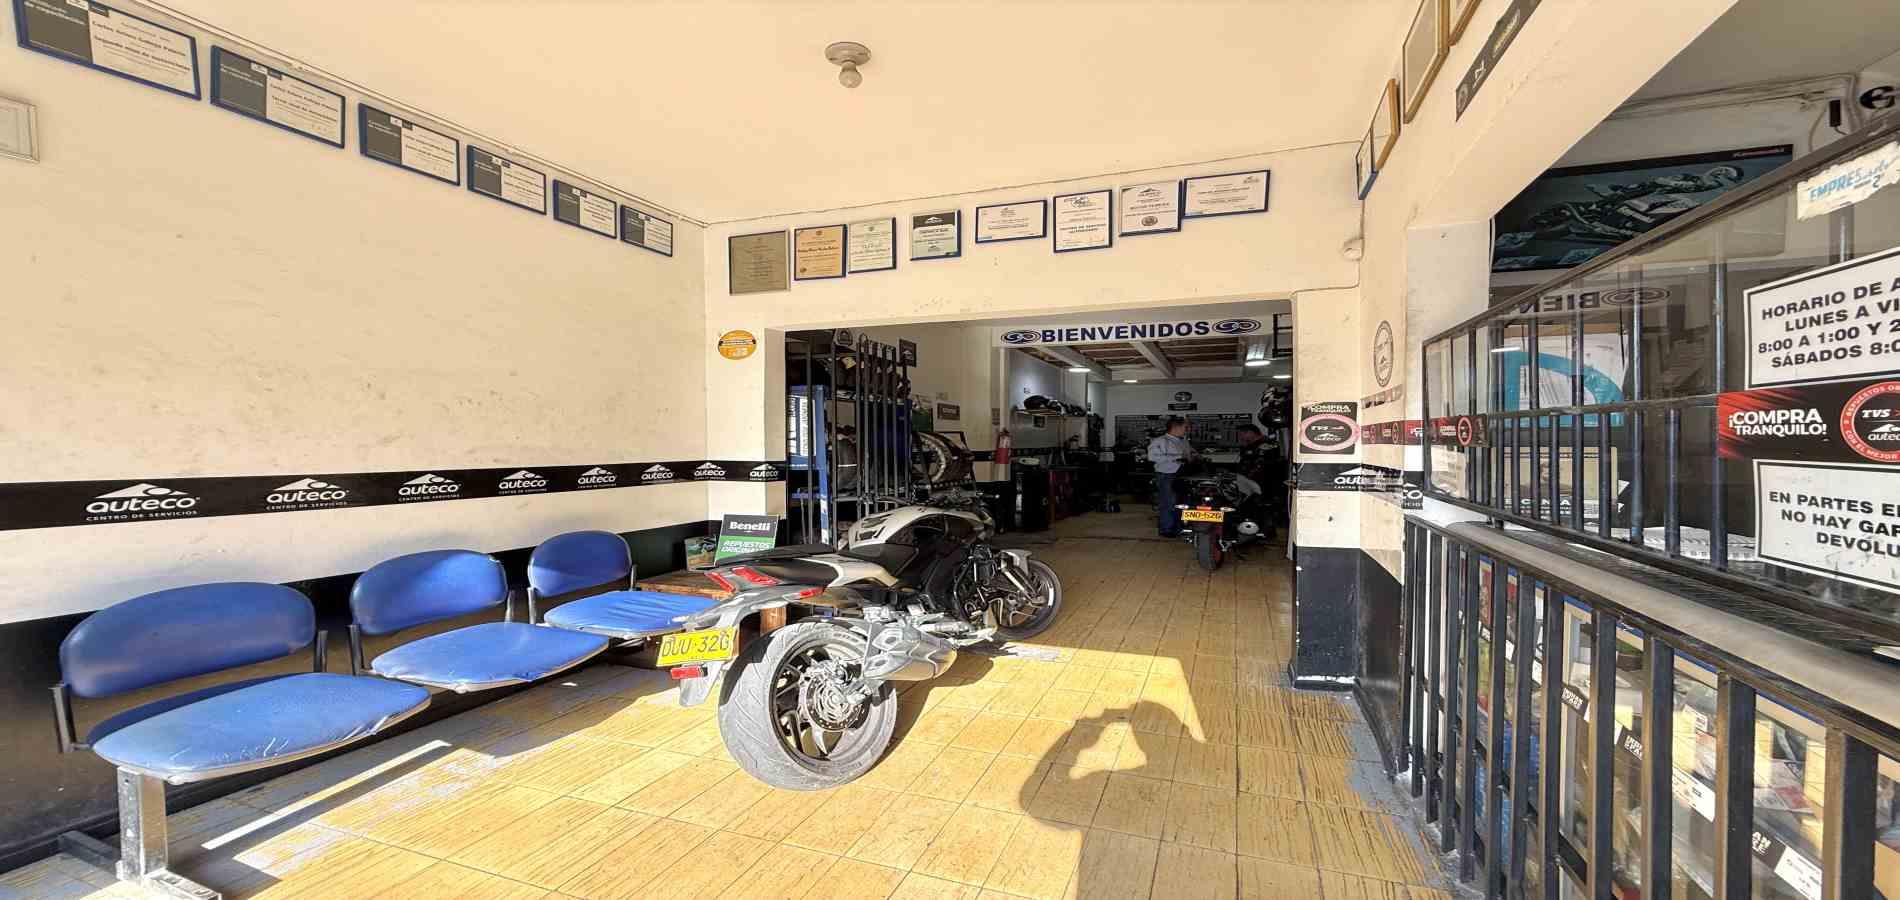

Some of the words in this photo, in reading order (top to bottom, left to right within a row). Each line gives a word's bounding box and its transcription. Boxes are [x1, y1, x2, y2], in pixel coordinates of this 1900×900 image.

[1762, 291, 1846, 320] HORARIO
[1853, 282, 1882, 300] DE
[1785, 309, 1848, 332] LUNES
[1855, 306, 1869, 319] A
[1041, 320, 1210, 344] BIENVENIDOS
[1758, 338, 1793, 353] 8:00
[1798, 335, 1810, 347] A
[1818, 326, 1860, 344] 1:00
[1867, 322, 1882, 335] Y
[1771, 344, 1862, 368] SÁBADOS
[1729, 408, 1822, 428] ¡COMPRA
[1862, 409, 1891, 419] TVS
[1734, 424, 1827, 437] TRANQUILO!
[578, 474, 616, 485] auteco
[641, 471, 673, 481] auteco
[694, 468, 725, 477] auteco
[749, 469, 778, 478] auteco
[398, 482, 459, 496] auteco
[499, 478, 546, 490] auteco
[266, 488, 346, 503] auteco
[1769, 491, 1791, 504] EN
[1797, 494, 1873, 514] PARTES
[86, 496, 196, 514] auteco
[87, 514, 128, 522] CENTRO
[149, 510, 197, 518] SERVICIOS
[1781, 509, 1806, 523] NO
[1812, 512, 1851, 530] HAY
[729, 521, 770, 531] Benelli
